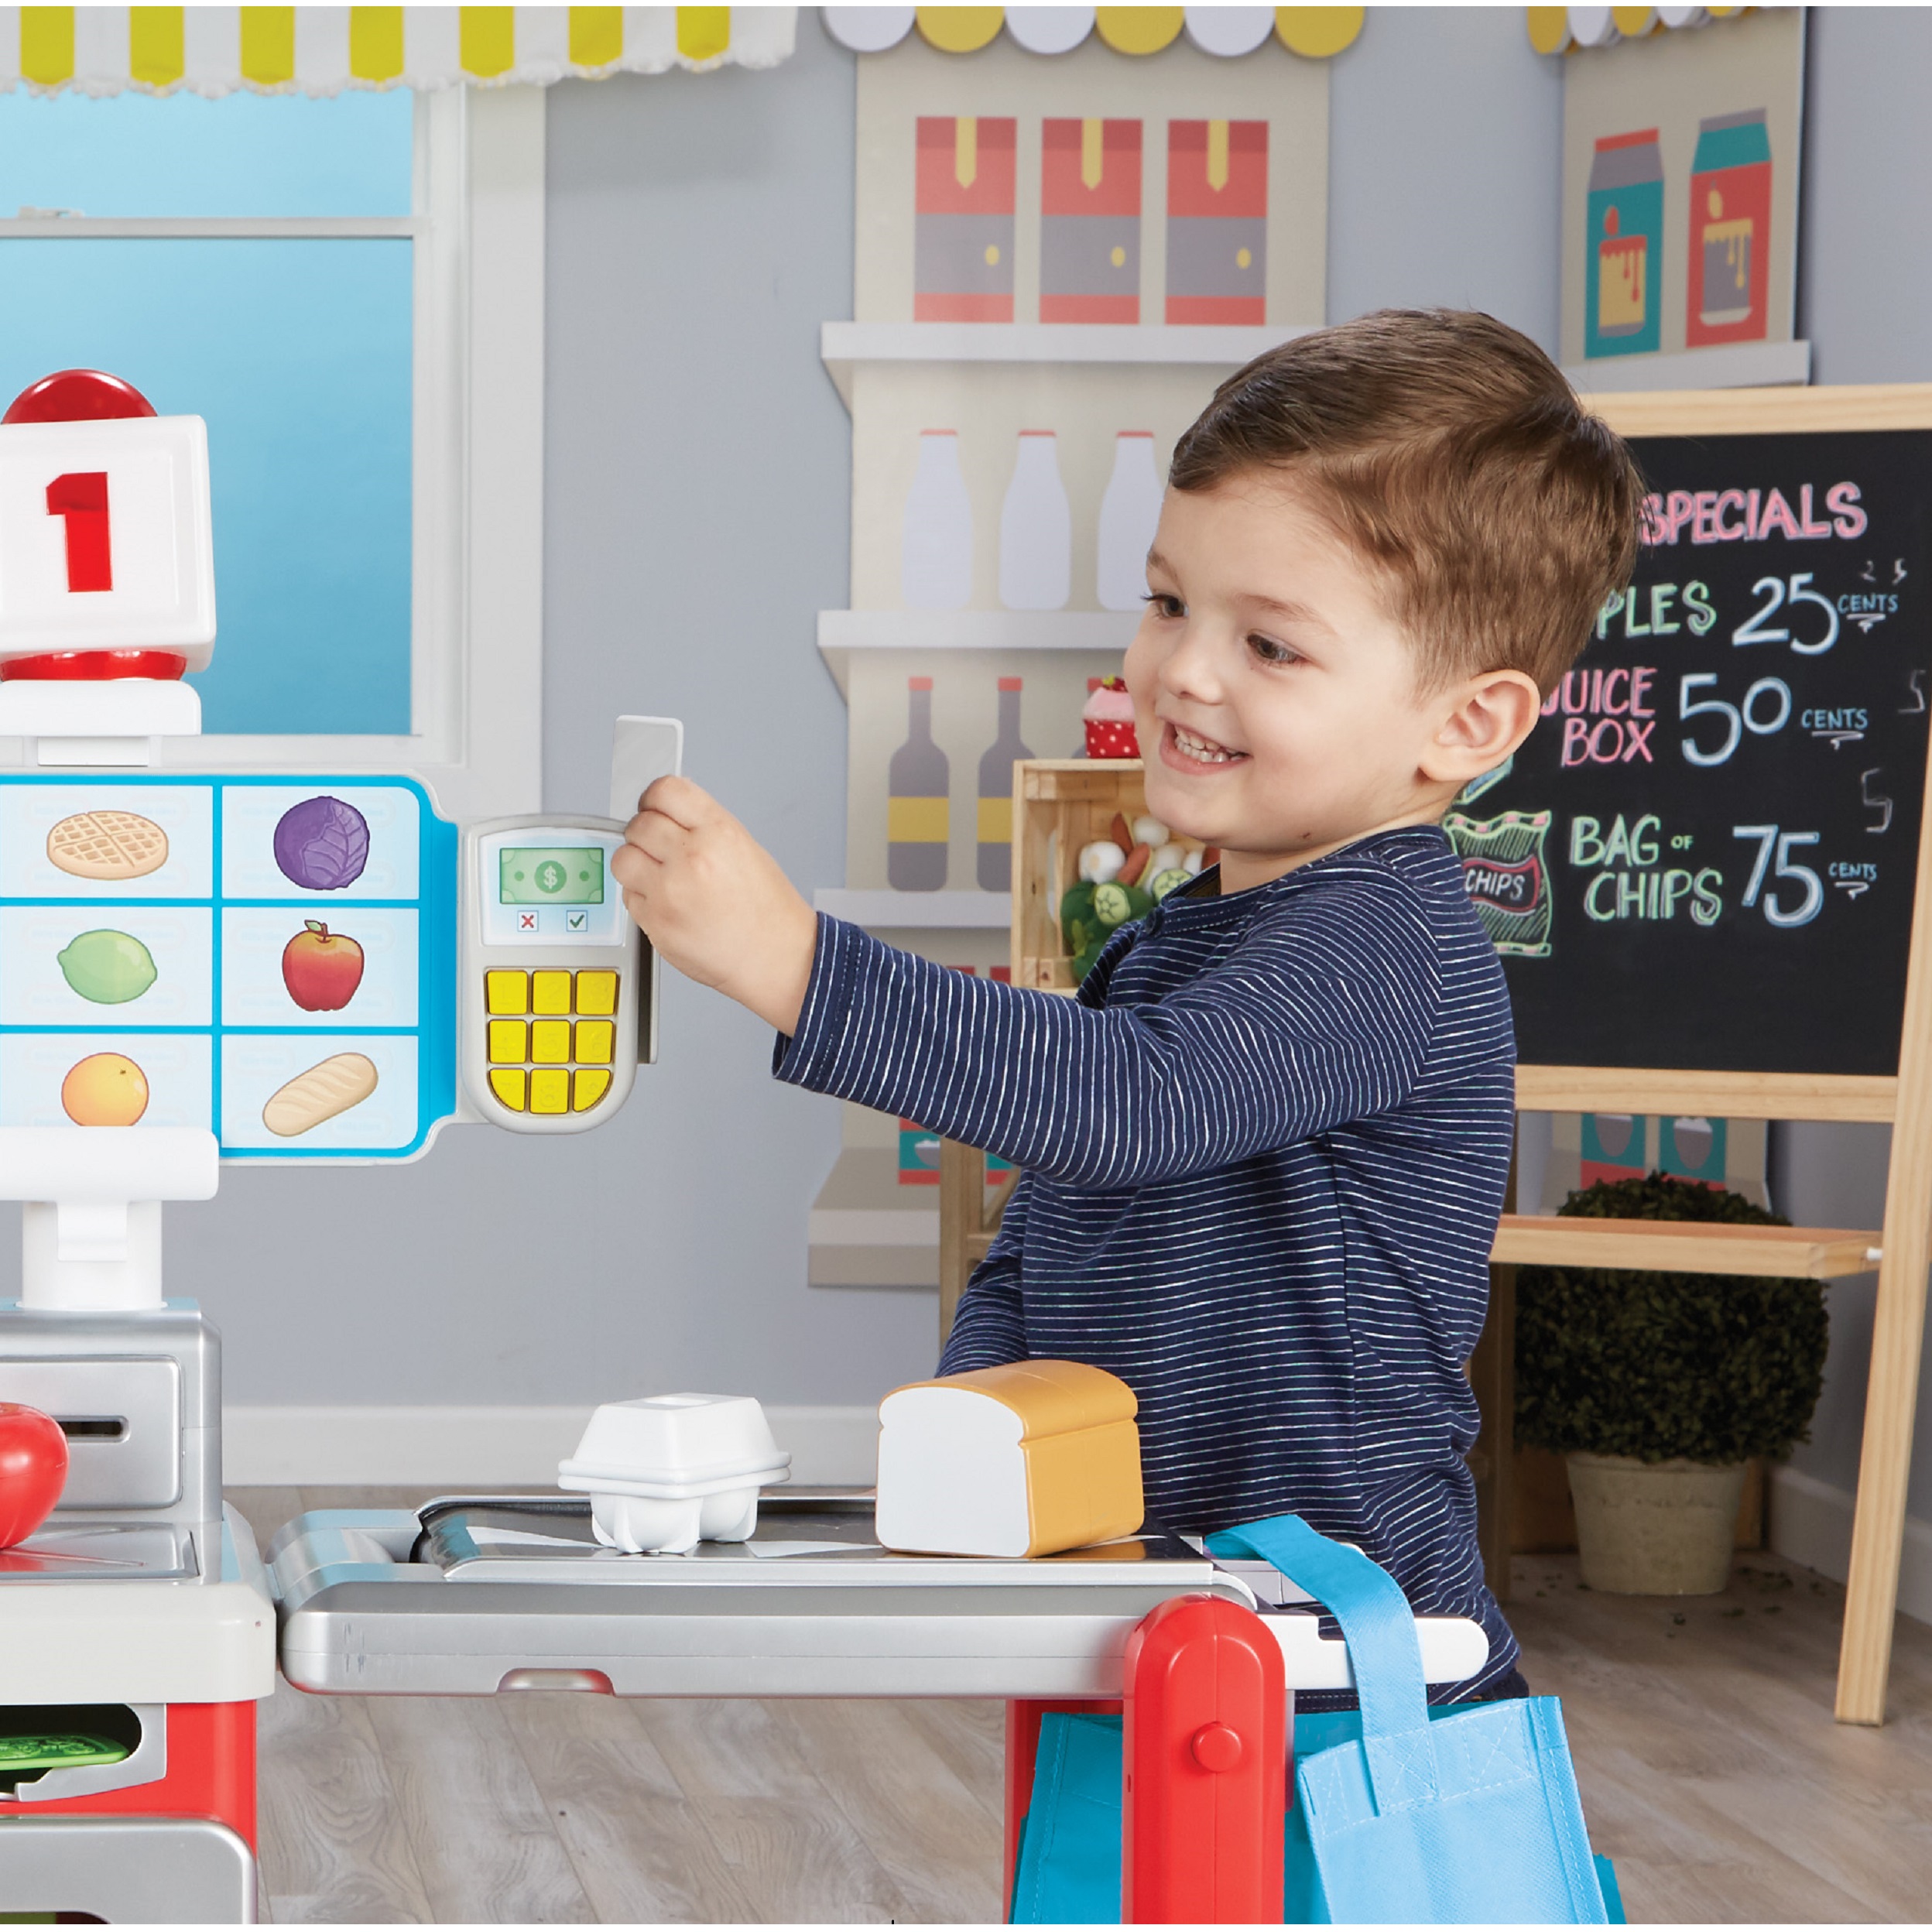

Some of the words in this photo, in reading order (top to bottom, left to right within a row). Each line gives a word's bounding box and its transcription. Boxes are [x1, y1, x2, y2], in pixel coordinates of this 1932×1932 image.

[45, 471, 115, 594] 1
[1638, 481, 1869, 545] SPECIALS
[1597, 581, 1717, 639] PLES
[1731, 572, 1841, 655] 25
[1837, 593, 1899, 614] CENTS
[1540, 666, 1657, 718] JUICE
[1679, 673, 1793, 766] 50
[1800, 707, 1869, 729] CENTS
[1560, 718, 1656, 768] BOX
[1465, 869, 1526, 902] CHIPS
[1569, 814, 1661, 868] BAG
[1670, 835, 1694, 850] OF
[1732, 824, 1824, 928] 75
[1584, 867, 1723, 926] CHIPS
[1828, 862, 1878, 882] CENTS
